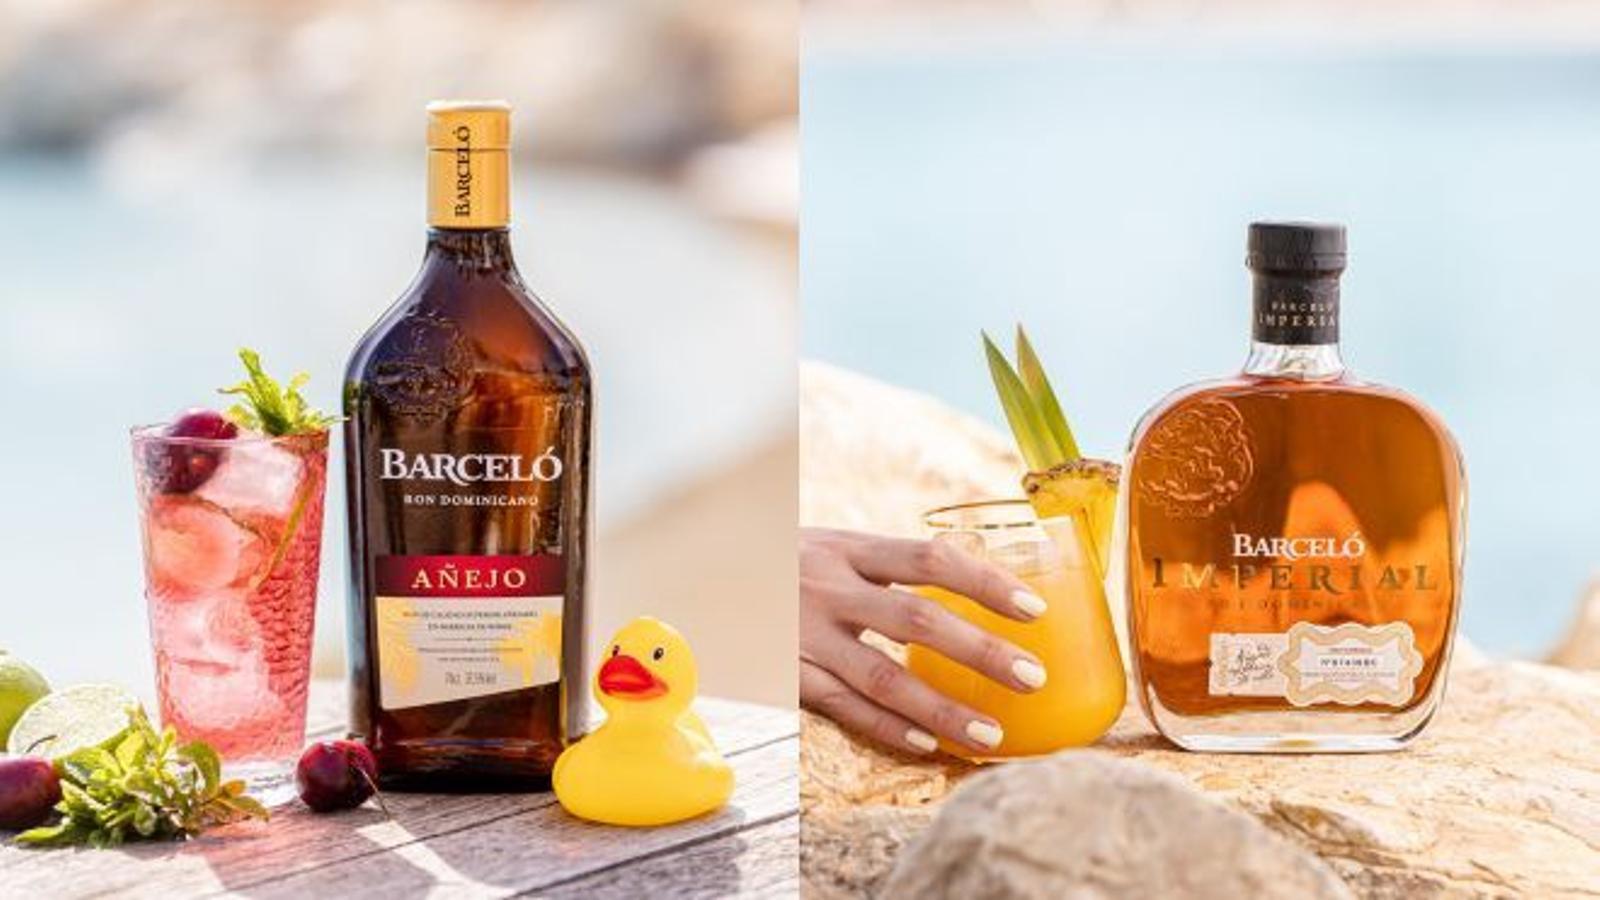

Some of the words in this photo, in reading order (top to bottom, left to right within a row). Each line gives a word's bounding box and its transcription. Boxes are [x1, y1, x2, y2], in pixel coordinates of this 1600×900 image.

[403, 494, 435, 506] RON
[440, 494, 539, 506] DOMINICANO
[411, 564, 526, 589] AÑEJO
[1152, 557, 1438, 595] IMPERIAL
